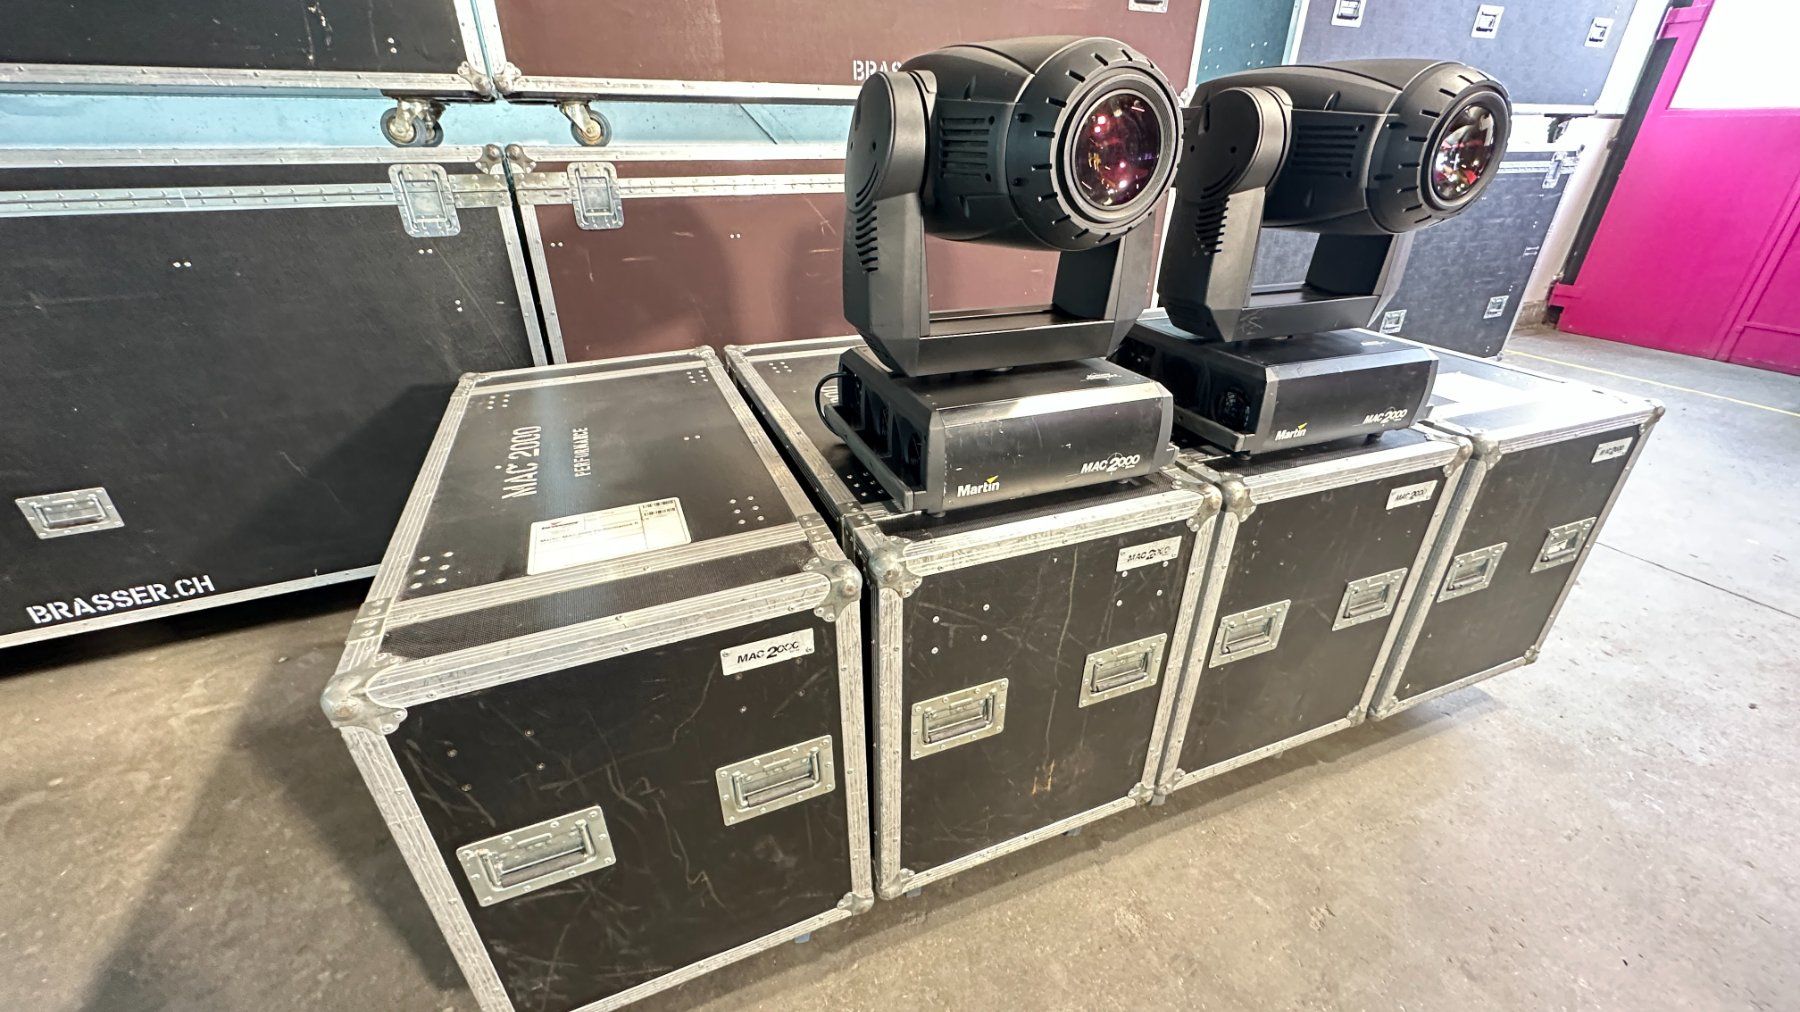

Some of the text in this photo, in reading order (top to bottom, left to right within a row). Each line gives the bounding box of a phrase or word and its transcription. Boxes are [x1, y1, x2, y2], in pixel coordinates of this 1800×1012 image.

[1380, 409, 1408, 424] 2000
[1275, 426, 1307, 441] Martin
[502, 425, 542, 499] MAC 2000
[1081, 454, 1140, 474] MAC 2000
[957, 479, 999, 498] Martin
[26, 574, 216, 625] BRASSER.CH
[737, 641, 799, 664] MAC 2000
